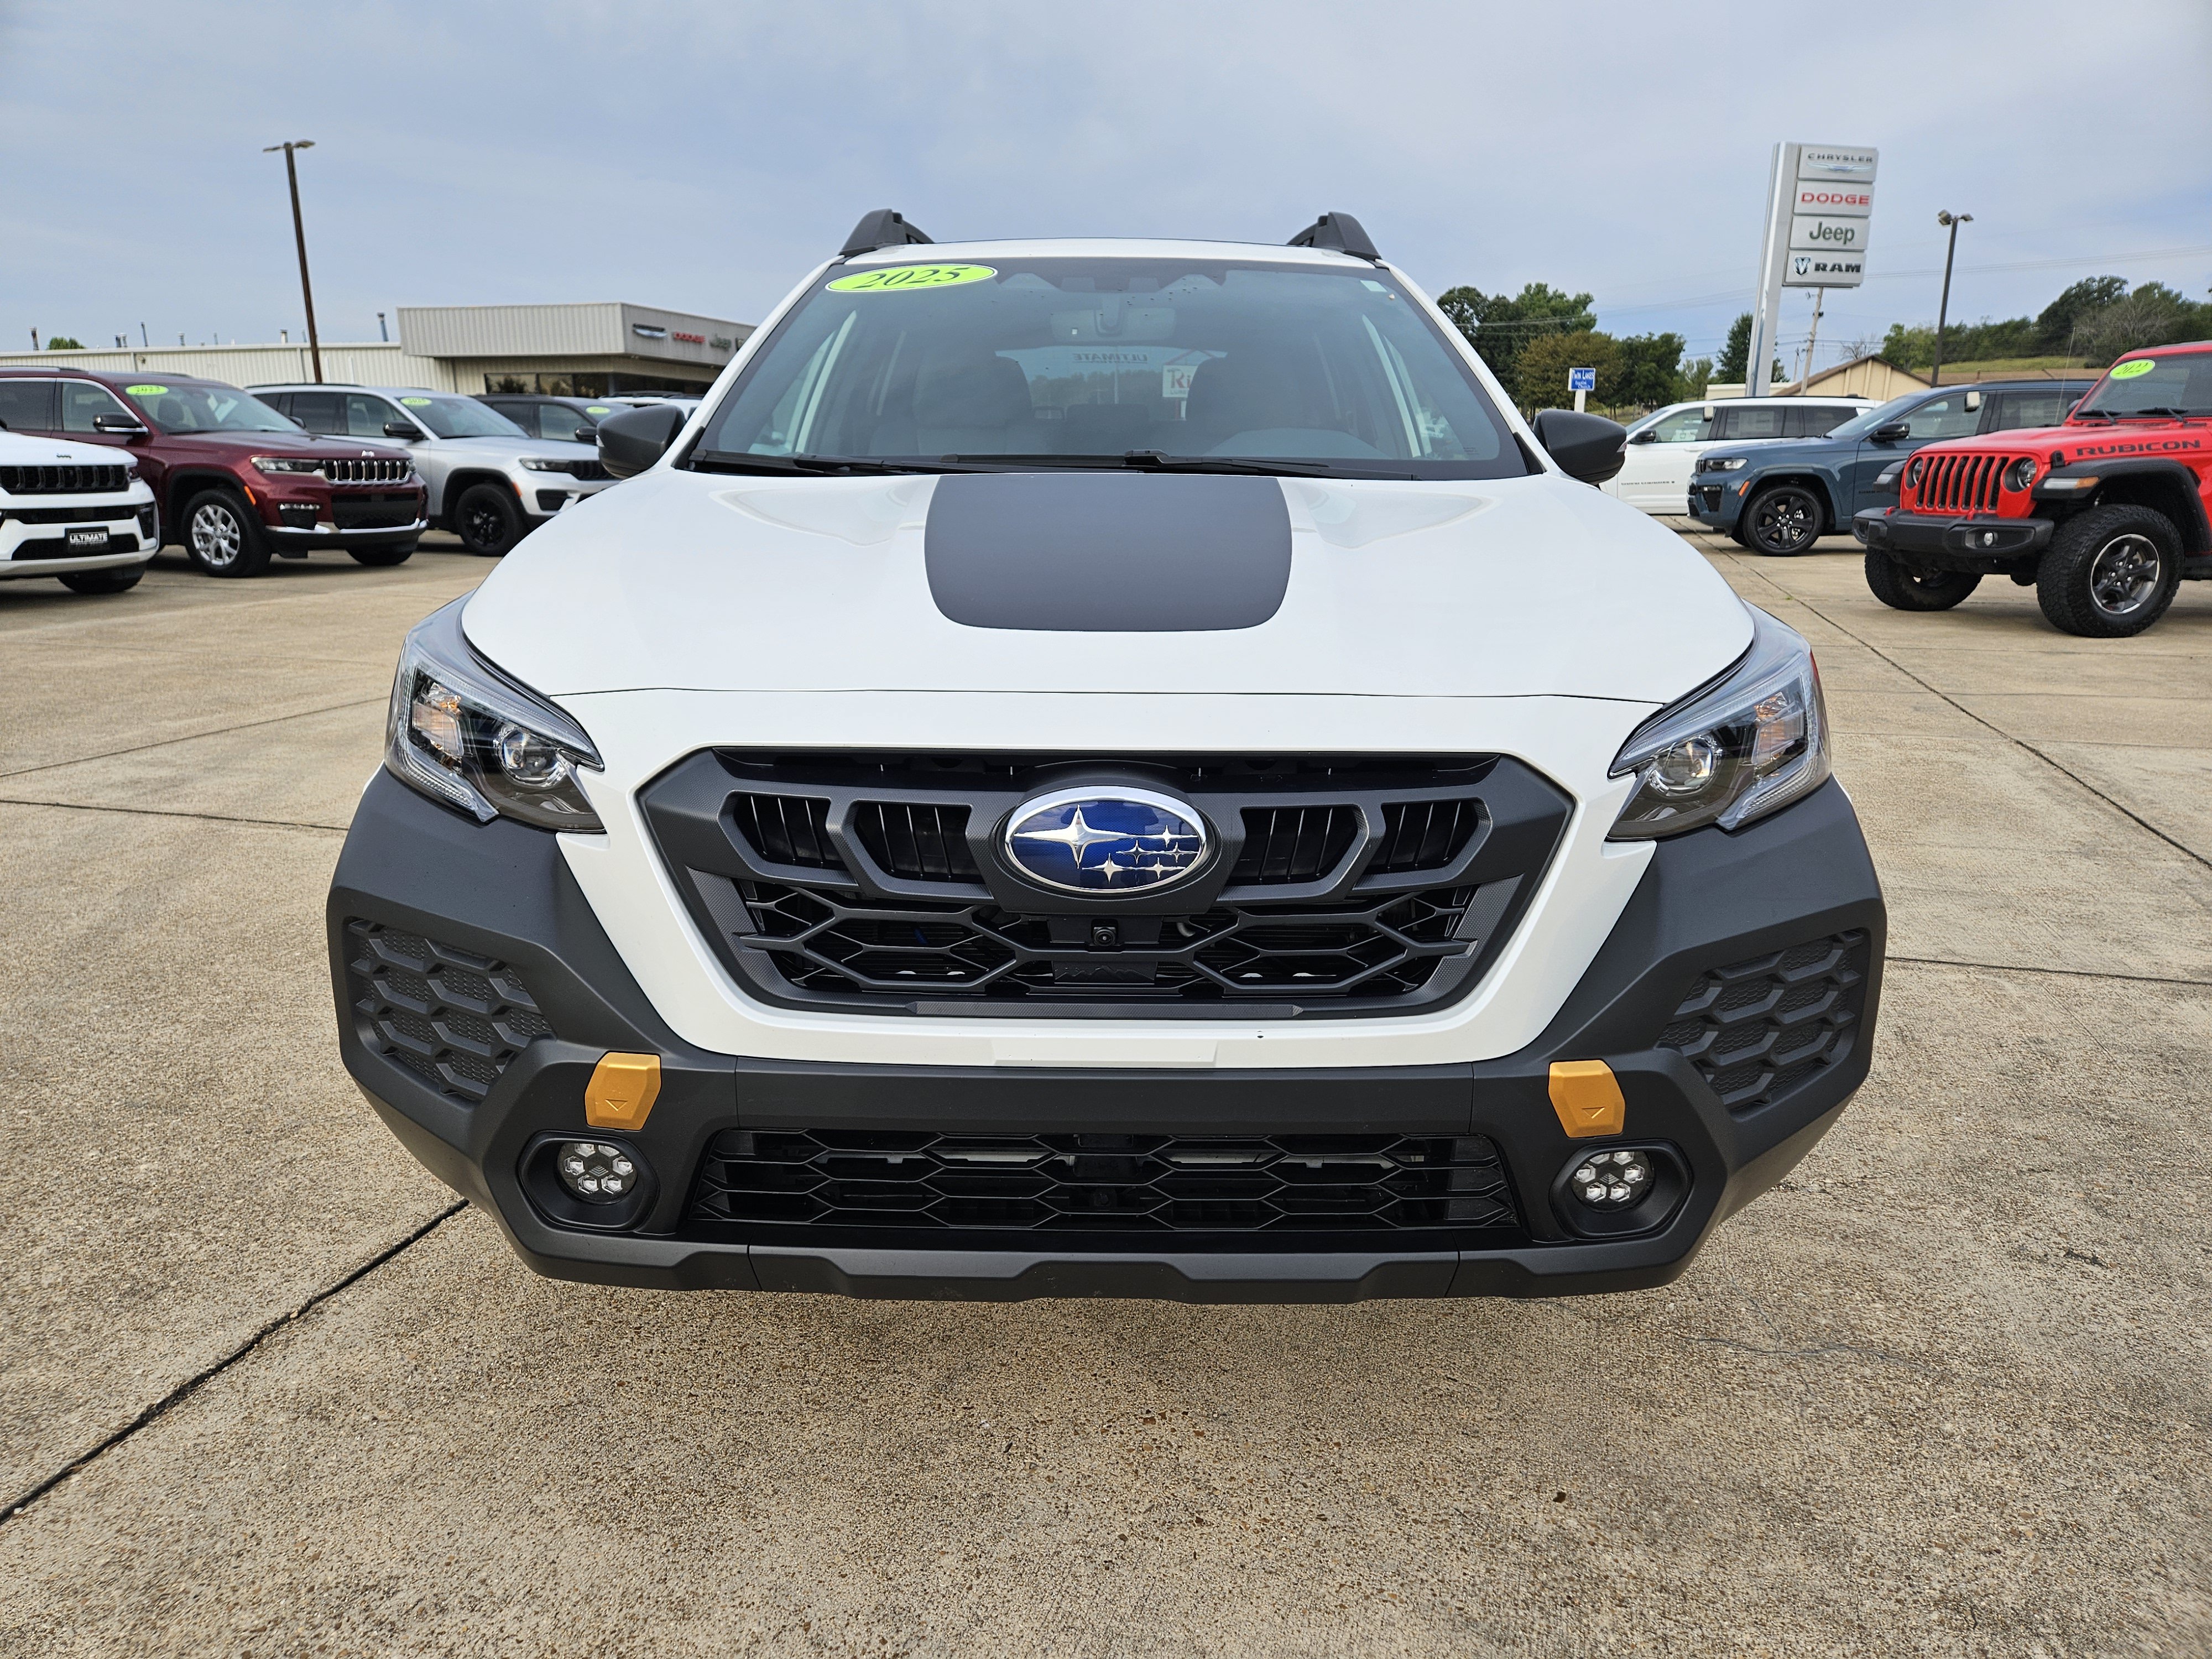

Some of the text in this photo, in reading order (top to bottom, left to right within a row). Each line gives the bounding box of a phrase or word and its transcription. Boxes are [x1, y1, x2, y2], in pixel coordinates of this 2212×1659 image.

[1808, 153, 1873, 162] CHRYSLER
[1801, 192, 1870, 206] DODGE
[1809, 221, 1855, 244] Jeep
[1814, 262, 1861, 273] RAM
[852, 267, 971, 289] 2025
[1167, 368, 1192, 389] Ri
[2077, 440, 2201, 456] RUBICON
[70, 533, 108, 543] ULTIMATE
